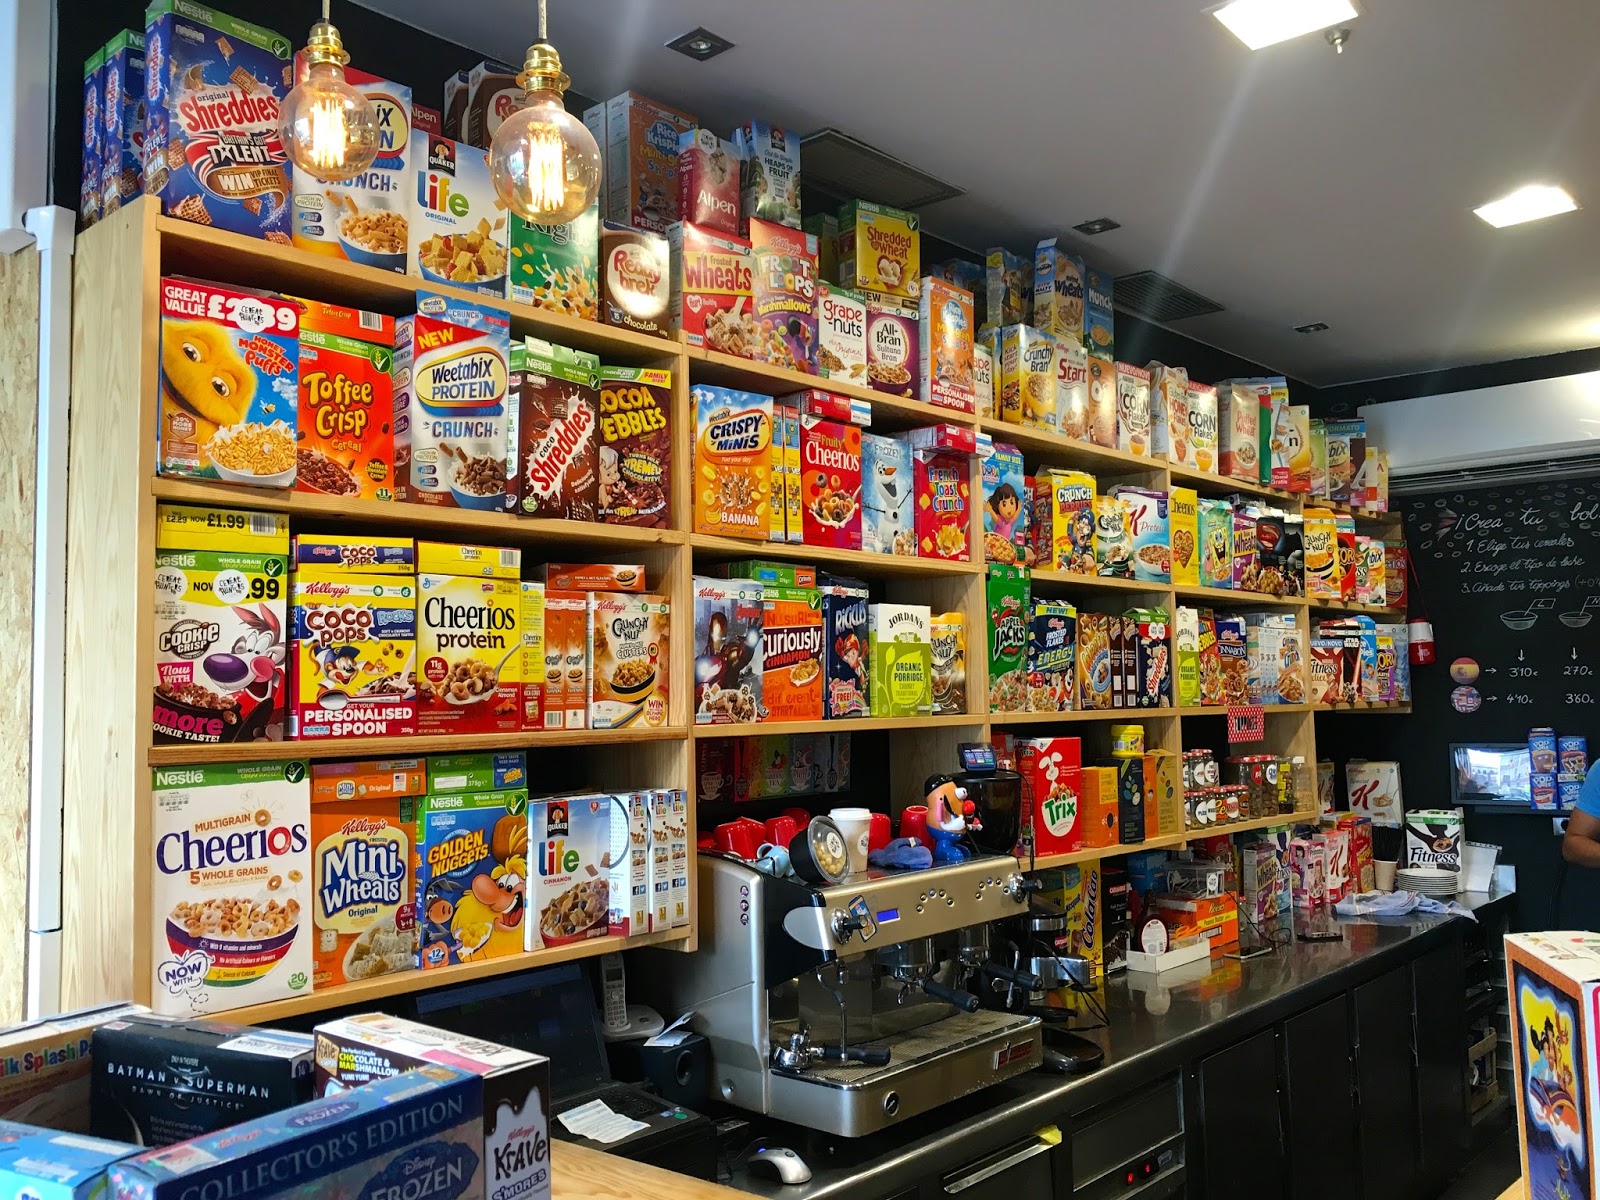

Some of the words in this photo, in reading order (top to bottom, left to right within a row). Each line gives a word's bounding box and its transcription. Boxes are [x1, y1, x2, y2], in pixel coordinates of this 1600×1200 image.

[197, 91, 230, 102] original
[180, 90, 279, 132] Shreddies
[429, 157, 455, 170] QUAKER
[218, 172, 254, 191] WIN
[769, 167, 790, 180] FRUIT
[697, 190, 737, 216] Alpen
[425, 211, 457, 225] ORIGINAL
[867, 226, 912, 248] Shredded
[710, 255, 732, 266] Frosted
[760, 253, 811, 277] FROOT
[684, 251, 752, 291] Wheats
[165, 286, 207, 304] GREAT
[769, 272, 816, 300] LOOPS
[165, 298, 206, 317] VALUE
[452, 310, 480, 320] CRUNCH
[757, 299, 812, 316] Marshmallows
[823, 300, 863, 324] grape
[623, 315, 658, 331] chocolate
[253, 335, 286, 353] HONEY
[417, 328, 454, 350] NEW
[876, 332, 901, 346] Bran
[238, 337, 295, 373] MONSTER
[876, 344, 901, 356] Sultana
[881, 352, 898, 363] Bran
[1023, 343, 1055, 363] Crunchy
[244, 349, 282, 376] Puffs
[432, 357, 493, 386] Weetabix
[526, 357, 553, 373] Nestlé
[1030, 360, 1050, 373] Bran
[1058, 357, 1087, 384] Start
[643, 370, 669, 381] FAMILY
[302, 370, 373, 405] Toffee
[432, 379, 495, 400] PROTEIN
[932, 384, 975, 404] PERSONALISED
[942, 396, 966, 409] SPOON
[1122, 394, 1150, 415] CORN
[316, 404, 368, 440] Crisp
[1128, 407, 1147, 424] Flakes
[1188, 409, 1217, 430] CORN
[1236, 410, 1257, 426] Puffed
[432, 420, 495, 438] CRUNCH
[710, 415, 763, 439] CRISPY
[1193, 426, 1213, 441] Flakes
[1236, 422, 1256, 438] Wheat
[331, 439, 362, 453] Cereal
[530, 403, 593, 492] Shreddies
[820, 436, 845, 450] Fruity
[805, 440, 860, 472] Cheerios
[994, 453, 1010, 463] FAMILY
[928, 465, 960, 482] French
[934, 481, 959, 498] Toast
[1057, 487, 1093, 503] CRUNCH
[931, 494, 965, 513] Crunch
[1060, 501, 1093, 513] BERRIES
[1170, 497, 1196, 517] Cheerios
[190, 515, 206, 523] NOW
[207, 512, 245, 530] £1.99
[721, 511, 760, 527] BANANA
[1130, 504, 1148, 537] K
[1519, 507, 1544, 526] tu
[1139, 520, 1167, 533] Protein
[461, 546, 483, 557] Cheerios
[1465, 539, 1474, 553] 1.
[1476, 538, 1508, 557] Elige
[1509, 535, 1531, 550] tus
[1533, 533, 1575, 549] cereales
[218, 556, 239, 565] WHOLE
[240, 558, 261, 566] GRAIN
[1460, 561, 1472, 574] 2.
[1509, 559, 1521, 571] el
[1522, 557, 1543, 574] tipo
[1545, 556, 1557, 568] de
[306, 581, 352, 598] Kellogg's
[698, 587, 726, 599] Kellogg's
[1460, 582, 1471, 594] 3.
[1507, 579, 1526, 591] tus
[1528, 578, 1571, 593] toppings
[424, 597, 516, 631] Cheerios
[597, 601, 627, 612] Kellogg's
[1046, 607, 1068, 616] NEW!
[377, 609, 415, 627] ROCKS
[888, 610, 925, 630] JORDANS
[1001, 616, 1019, 628] APPLE
[612, 616, 650, 639] CRUNCHY
[623, 630, 642, 642] NUT
[1046, 628, 1067, 640] FROSTED
[177, 640, 208, 654] CRISP
[436, 631, 506, 653] protein
[522, 633, 543, 643] Cheerios
[993, 625, 1026, 661] JACKS
[1046, 636, 1064, 648] FLAKES
[765, 650, 811, 666] CINNAMON
[1037, 645, 1075, 666] ENERGY
[895, 662, 923, 672] ORGANIC
[1147, 647, 1168, 693] Shreddies
[163, 673, 190, 684] WITH
[894, 672, 923, 683] PORRIDGE
[648, 700, 664, 709] WIN
[153, 702, 225, 735] more
[305, 707, 414, 722] PERSONALISED
[185, 731, 221, 744] TASTE!
[332, 721, 387, 736] SPOON
[237, 766, 260, 774] WHOLE
[262, 765, 282, 773] GRAIN
[156, 771, 205, 787] Nestlé
[369, 784, 391, 792] Original
[430, 796, 464, 809] Nestlé
[1351, 778, 1380, 811] K
[1045, 793, 1078, 827] Trix
[194, 812, 251, 833] MULTIGRAIN
[341, 818, 388, 836] Kellogg's
[547, 821, 568, 831] QUAKER
[156, 823, 308, 875] Cheerios
[428, 829, 485, 867] GOLDEN
[1410, 845, 1457, 866] Fitness
[325, 840, 398, 886] Mini
[431, 846, 489, 878] NUGGETS
[189, 871, 201, 885] 5
[202, 869, 235, 881] WHOLE
[236, 866, 269, 878] GRAINS
[543, 875, 572, 885] CINNAMON
[324, 874, 400, 916] Wheats
[348, 906, 378, 918] Original
[165, 962, 202, 981] NOW
[290, 972, 305, 983] 20
[24, 1042, 76, 1074] Splash
[339, 1053, 383, 1068] CHOCOLATE
[338, 1061, 399, 1077] MARSHMALLOW
[108, 1062, 166, 1083] BATMAN
[186, 1077, 270, 1100] SUPERMAN
[131, 1085, 162, 1097] DAWN
[190, 1095, 240, 1110] JUSTICE
[180, 1131, 358, 1200] COLLECTOR'S
[366, 1094, 464, 1149] EDITION
[402, 1154, 436, 1176] Disney
[370, 1157, 463, 1200] FROZEN
[492, 1168, 547, 1200] S'MORES
